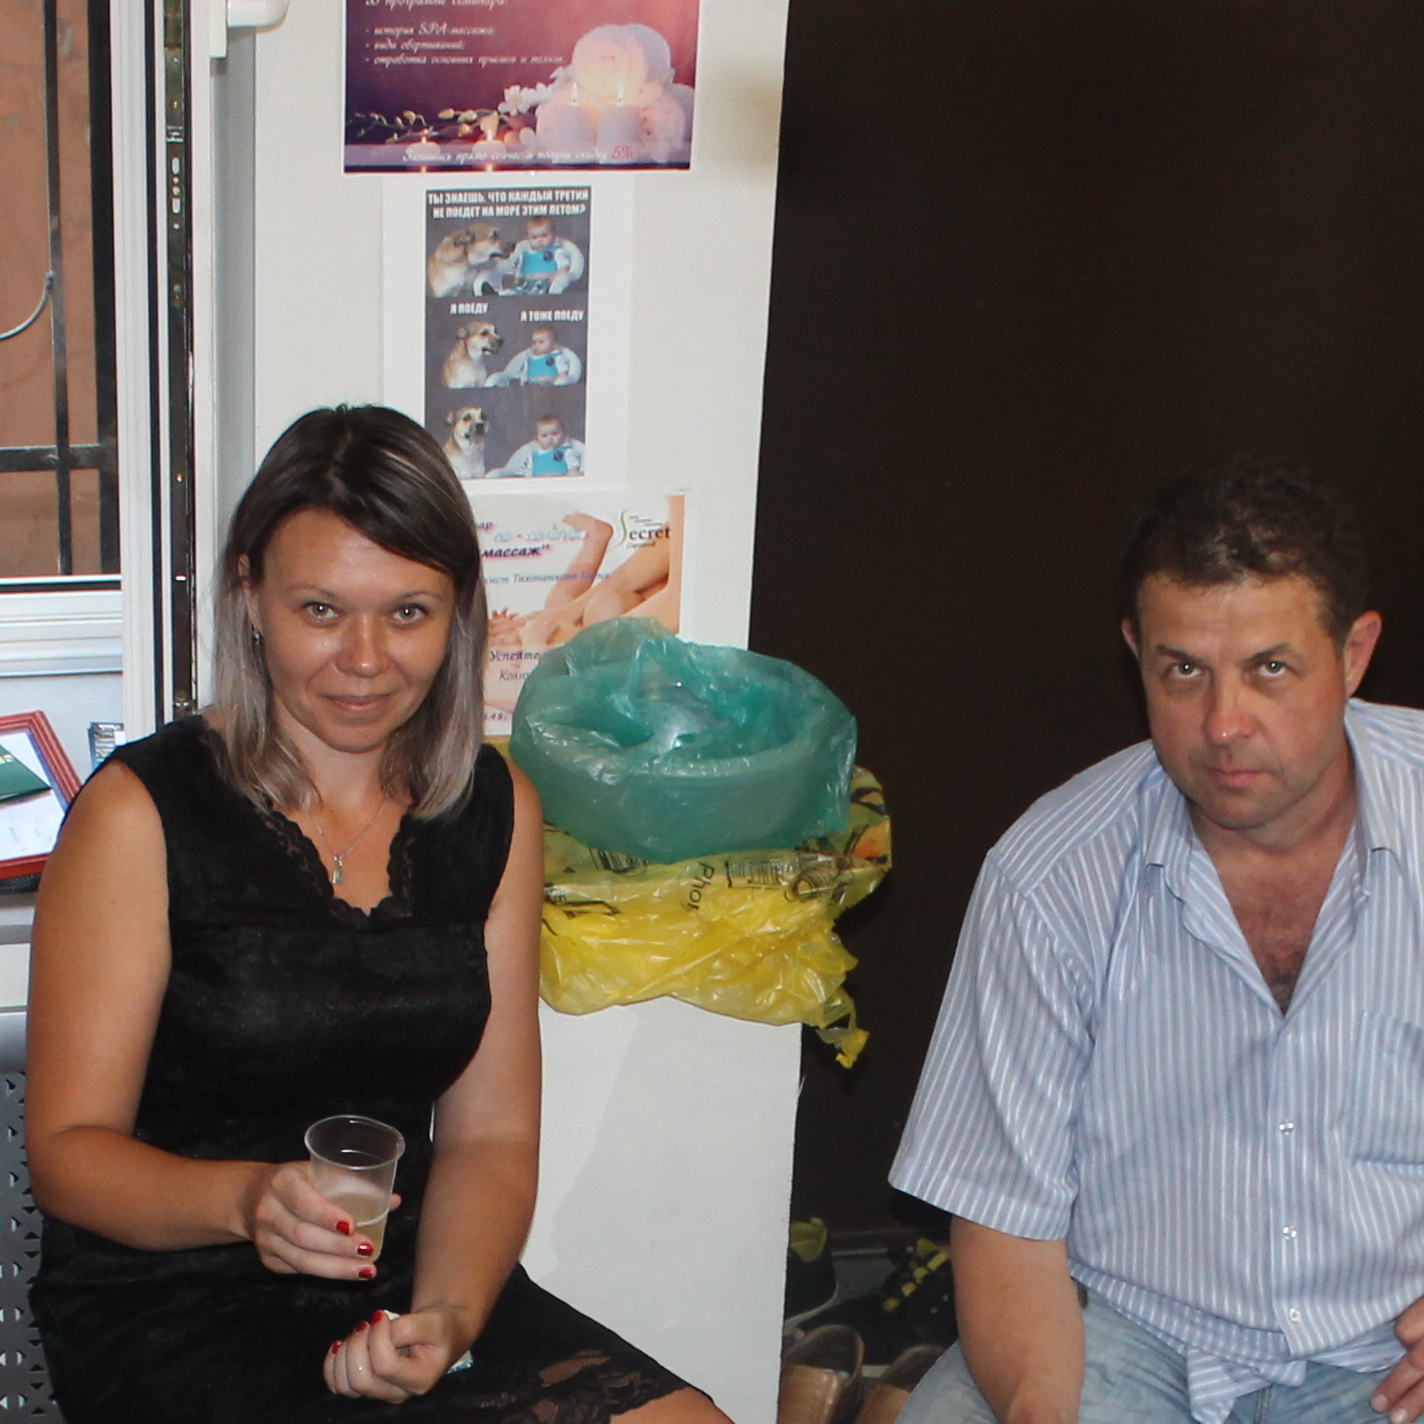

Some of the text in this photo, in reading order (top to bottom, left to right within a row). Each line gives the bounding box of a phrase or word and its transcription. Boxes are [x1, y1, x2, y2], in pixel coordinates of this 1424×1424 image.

[428, 193, 444, 205] ТЫ
[488, 191, 507, 204] ЧТО
[433, 206, 444, 219] НЕ
[445, 206, 481, 219] ПОЕДЕТ
[482, 206, 494, 217] НА
[495, 205, 520, 217] МОРЕ
[521, 204, 548, 216] ЭТИМ
[458, 302, 489, 315] ПОЕДУ
[554, 309, 585, 322] ПОЕДУ
